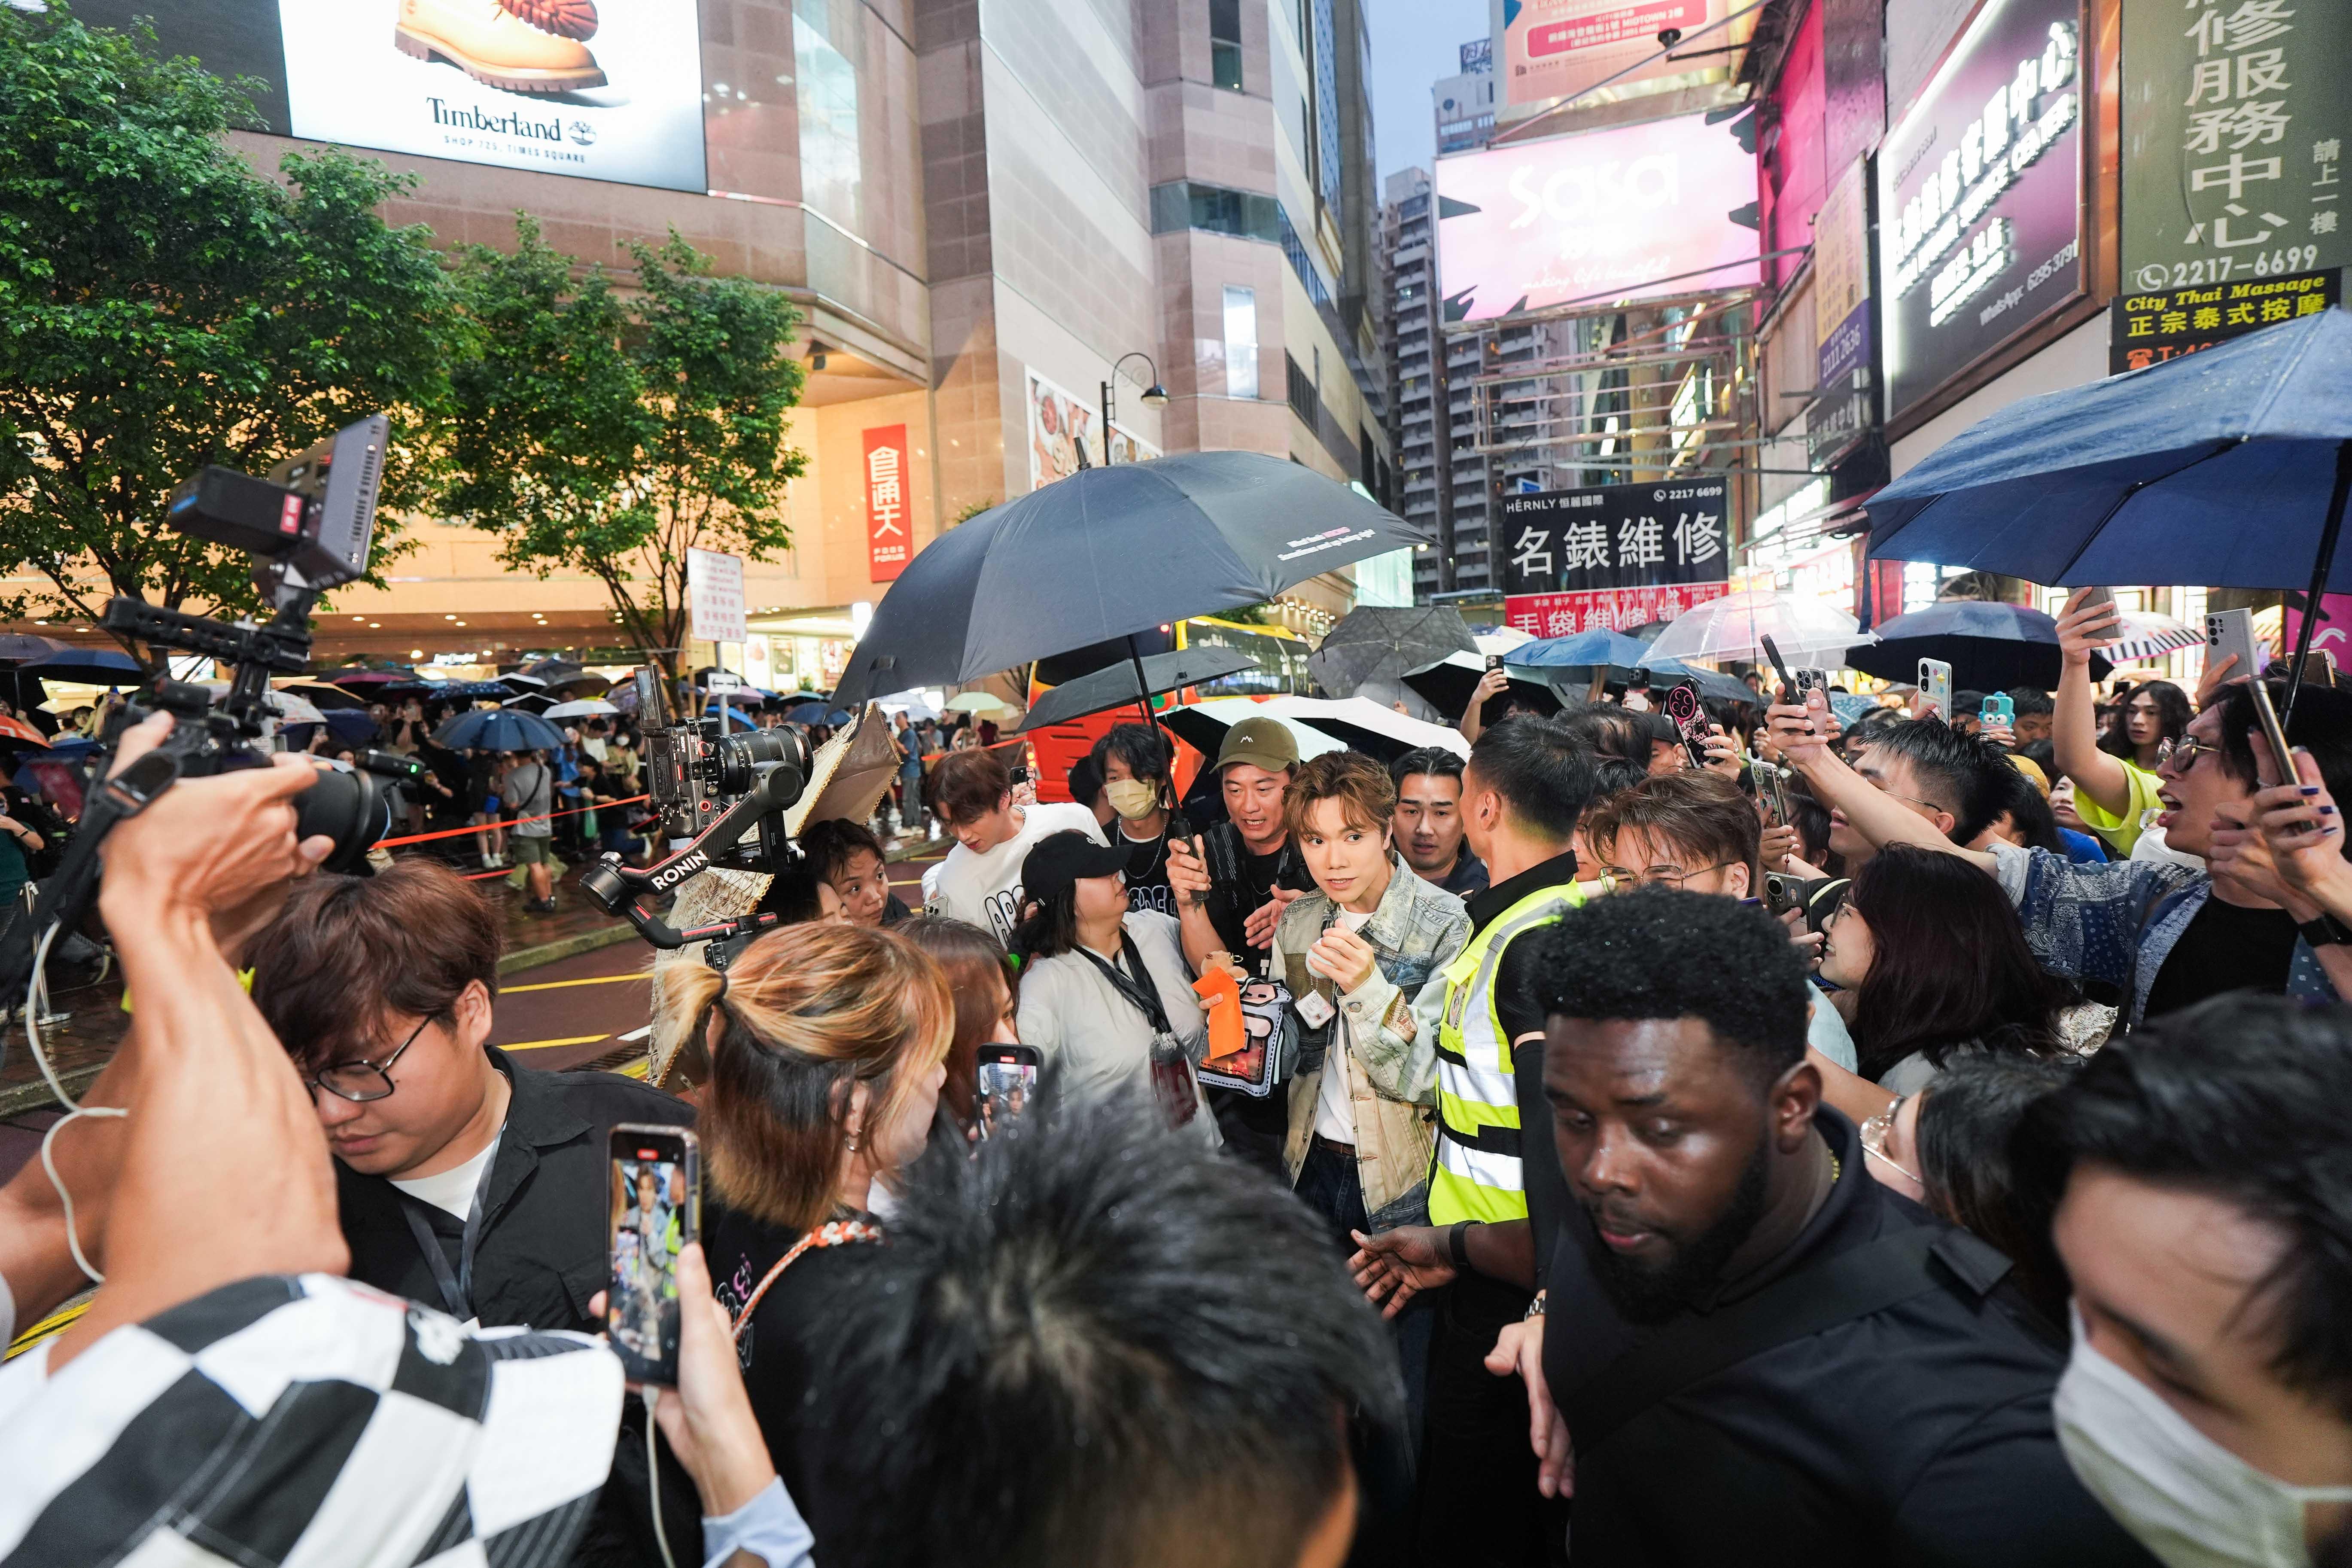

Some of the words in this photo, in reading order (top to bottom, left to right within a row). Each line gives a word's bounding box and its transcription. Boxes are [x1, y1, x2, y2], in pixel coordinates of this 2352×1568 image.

[426, 97, 561, 140] Timberland
[2183, 0, 2296, 248] 修服務中心
[444, 136, 473, 146] SHOP
[508, 144, 539, 156] TIMES
[545, 150, 585, 163] SQUARE
[2309, 138, 2340, 234] 請上一樓
[2173, 244, 2318, 287] 2217-6699
[2125, 297, 2168, 311] City
[2176, 287, 2222, 306] Thai
[2229, 277, 2325, 298] Massage
[2127, 293, 2325, 337] 正宗泰式按摩
[1506, 498, 1556, 513] HÉRNLY
[1669, 488, 1694, 499] 2217
[1696, 486, 1722, 497] 6699
[1511, 512, 1722, 577] 名錶維修
[1681, 715, 1701, 732] BLACKCAT
[651, 850, 708, 890] RONIN
